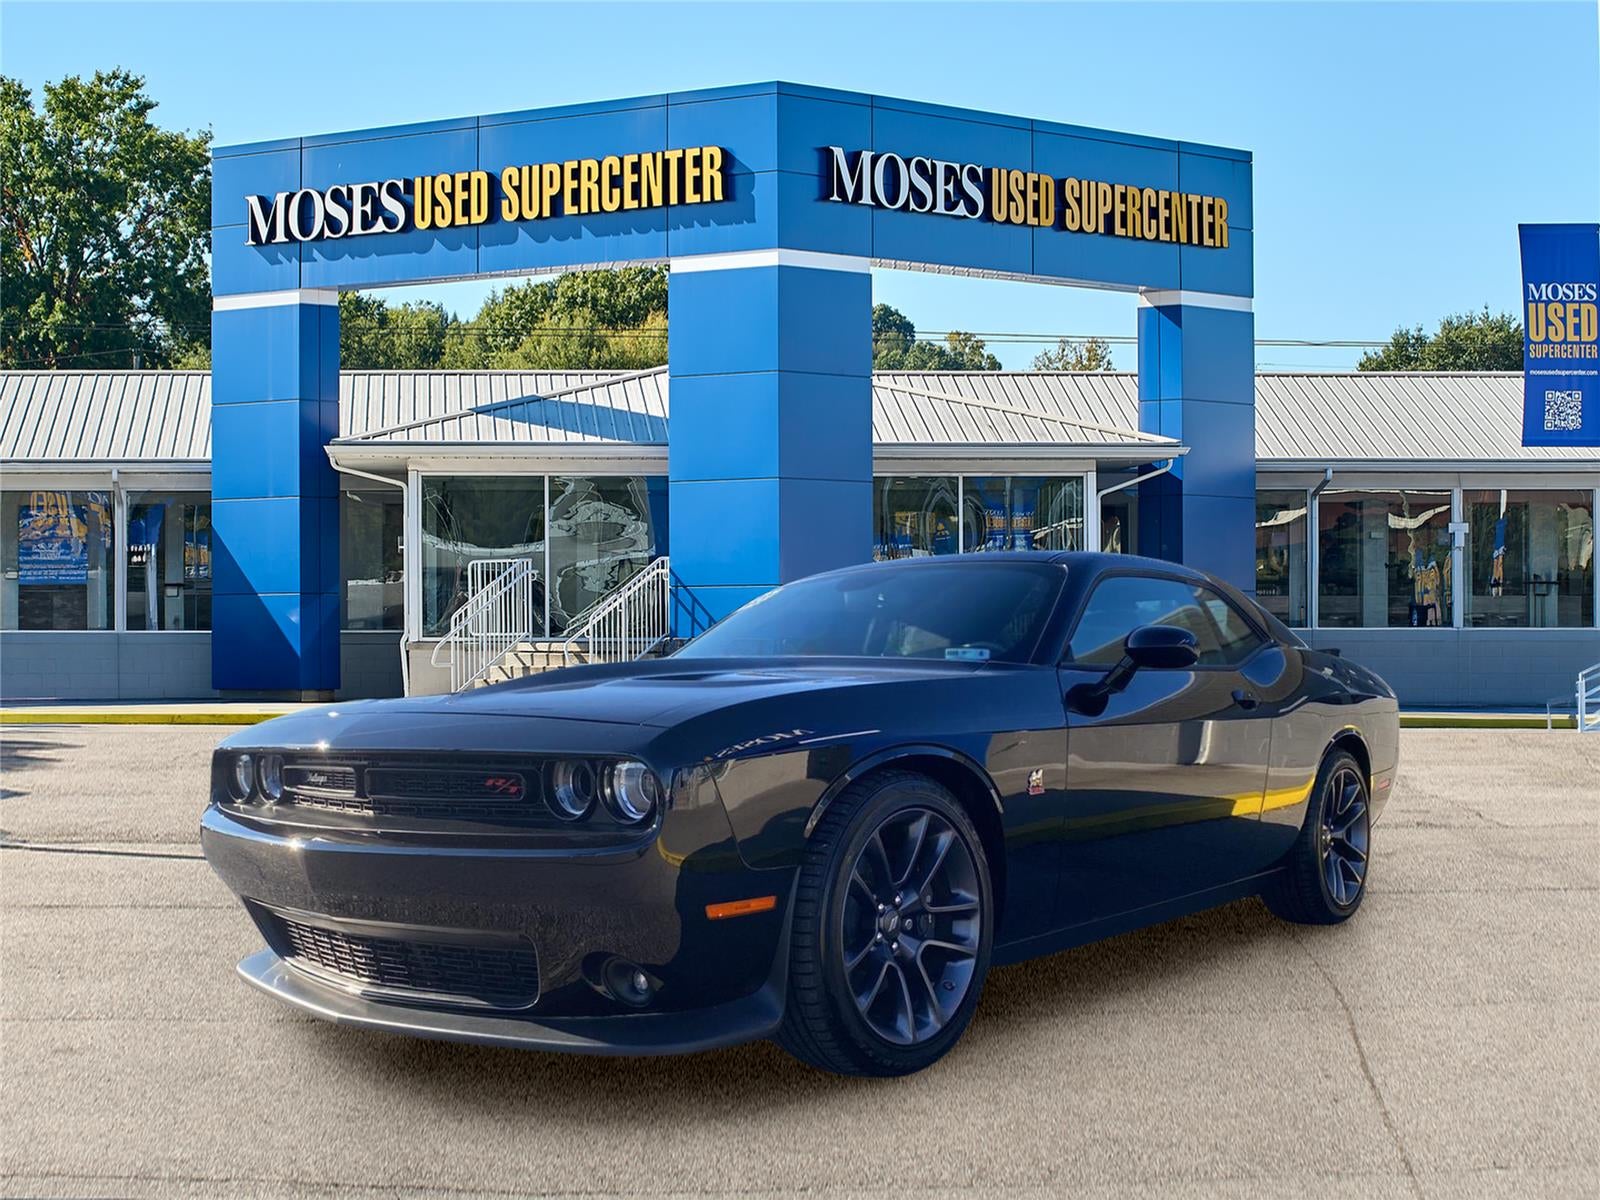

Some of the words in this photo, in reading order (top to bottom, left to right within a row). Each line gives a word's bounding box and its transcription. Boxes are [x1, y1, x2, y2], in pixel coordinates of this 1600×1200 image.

[245, 179, 406, 246] MOSES
[414, 170, 488, 230] USED
[501, 145, 723, 222] SUPERCENTER
[829, 146, 984, 219] MOSES
[991, 167, 1055, 227] USED
[1065, 177, 1229, 248] SUPERCENTER
[1527, 282, 1597, 301] MOSES
[1528, 302, 1598, 342] USED
[1529, 344, 1598, 358] SUPERCENTER
